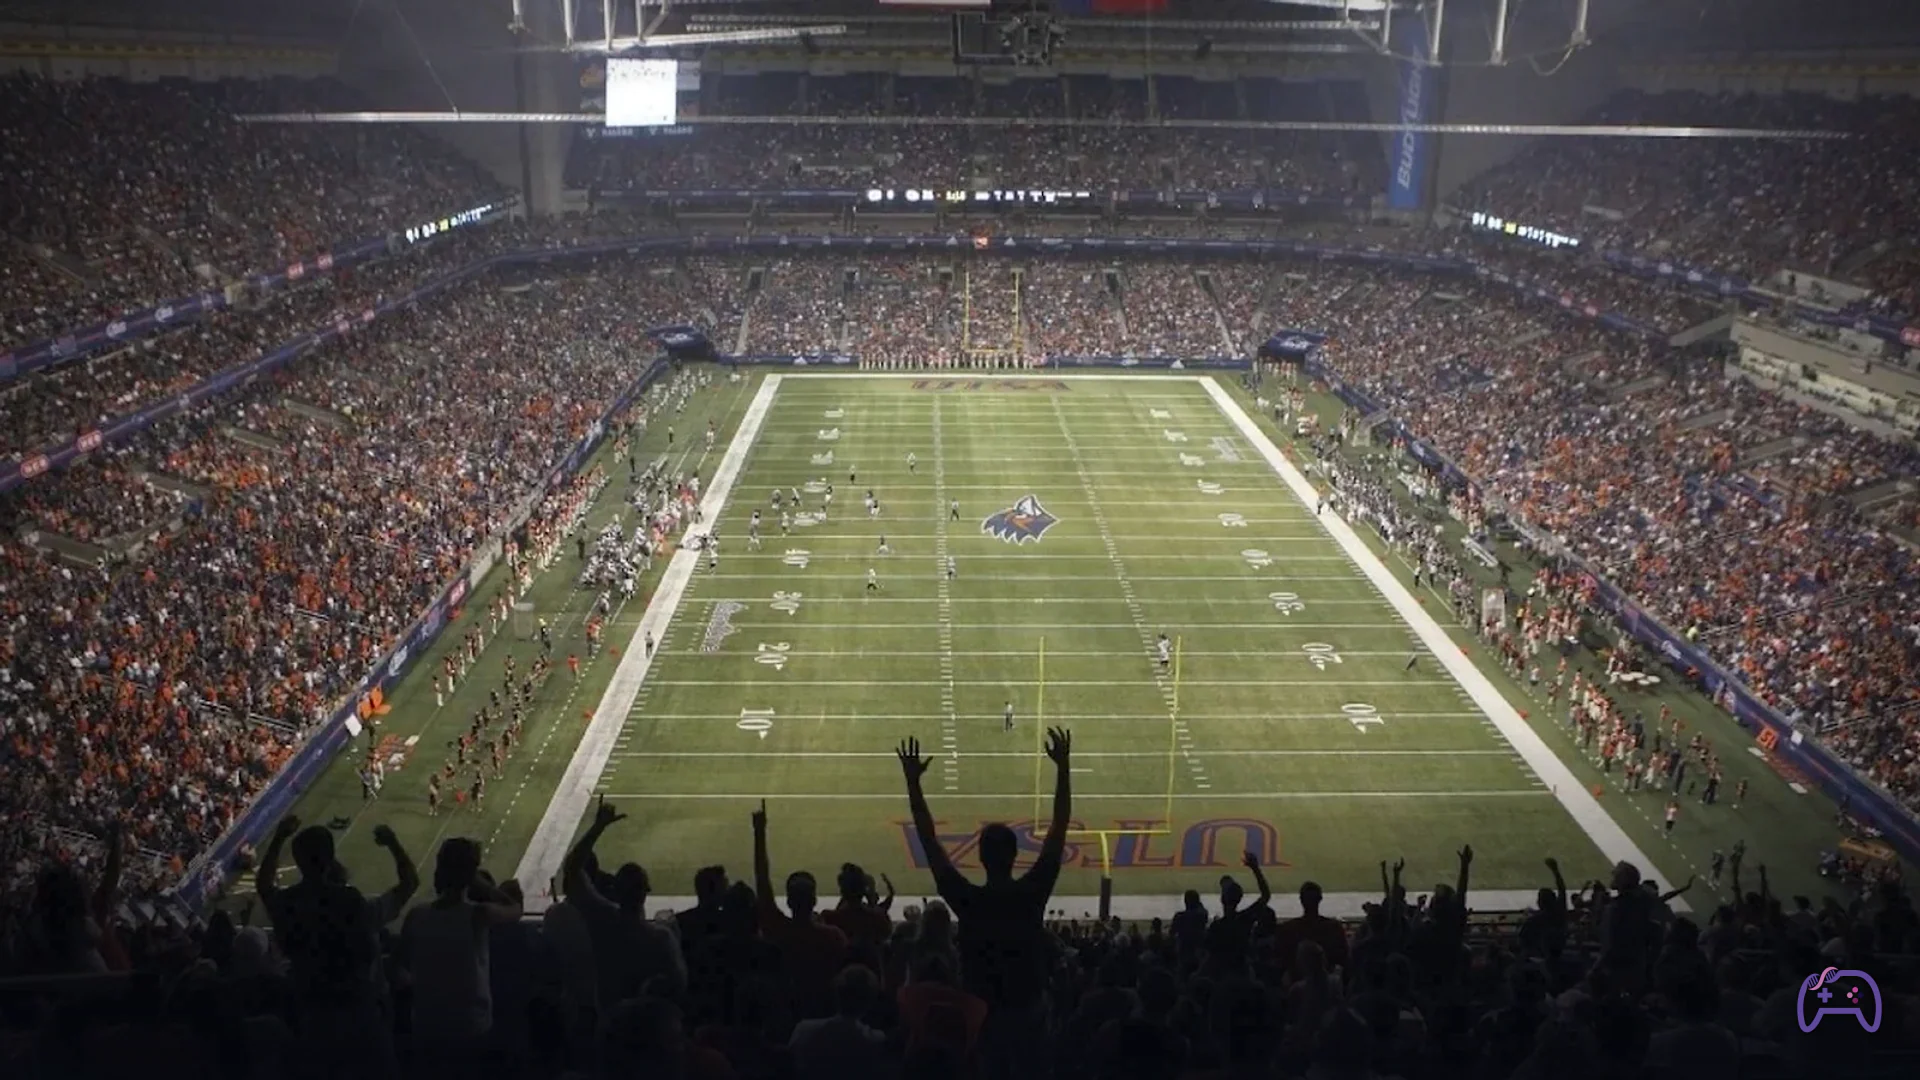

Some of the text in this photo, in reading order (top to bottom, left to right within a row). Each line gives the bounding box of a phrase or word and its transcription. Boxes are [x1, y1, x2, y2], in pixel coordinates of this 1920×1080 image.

[1397, 132, 1415, 189] BUD
[770, 591, 802, 610] 30
[1268, 592, 1306, 611] 30
[754, 642, 790, 663] 20
[1302, 642, 1342, 663] 20
[736, 708, 775, 730] 10
[1341, 703, 1384, 725] 10
